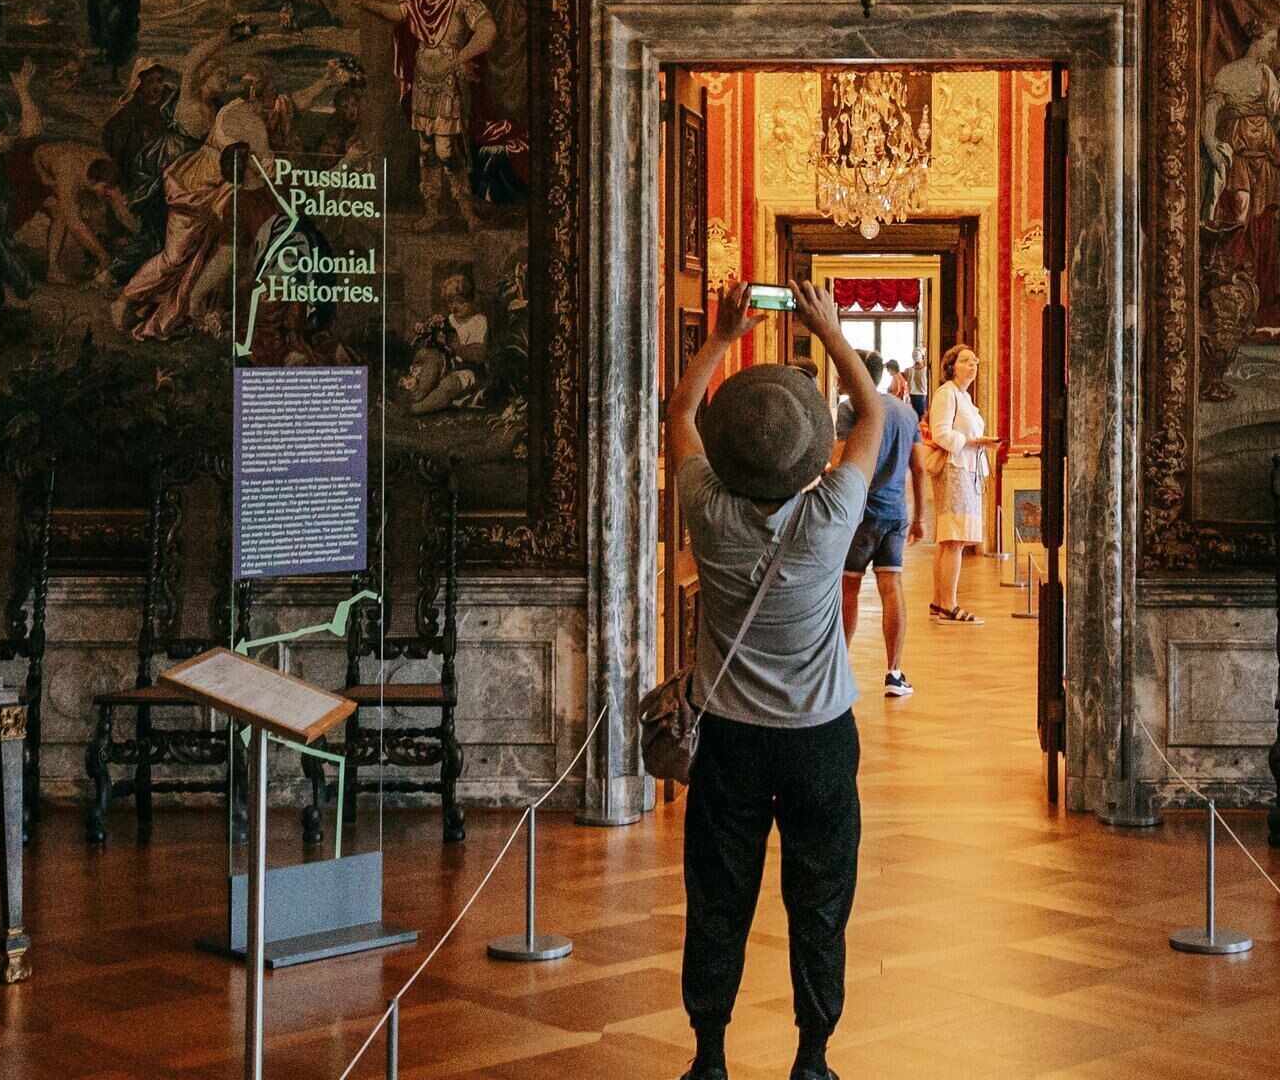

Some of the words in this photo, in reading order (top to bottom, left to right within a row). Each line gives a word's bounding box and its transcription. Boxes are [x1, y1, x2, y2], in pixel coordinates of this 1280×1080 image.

[274, 159, 376, 190] Prussian
[289, 189, 380, 218] Palaces.
[277, 246, 376, 274] Colonial
[268, 275, 379, 303] Histories.
